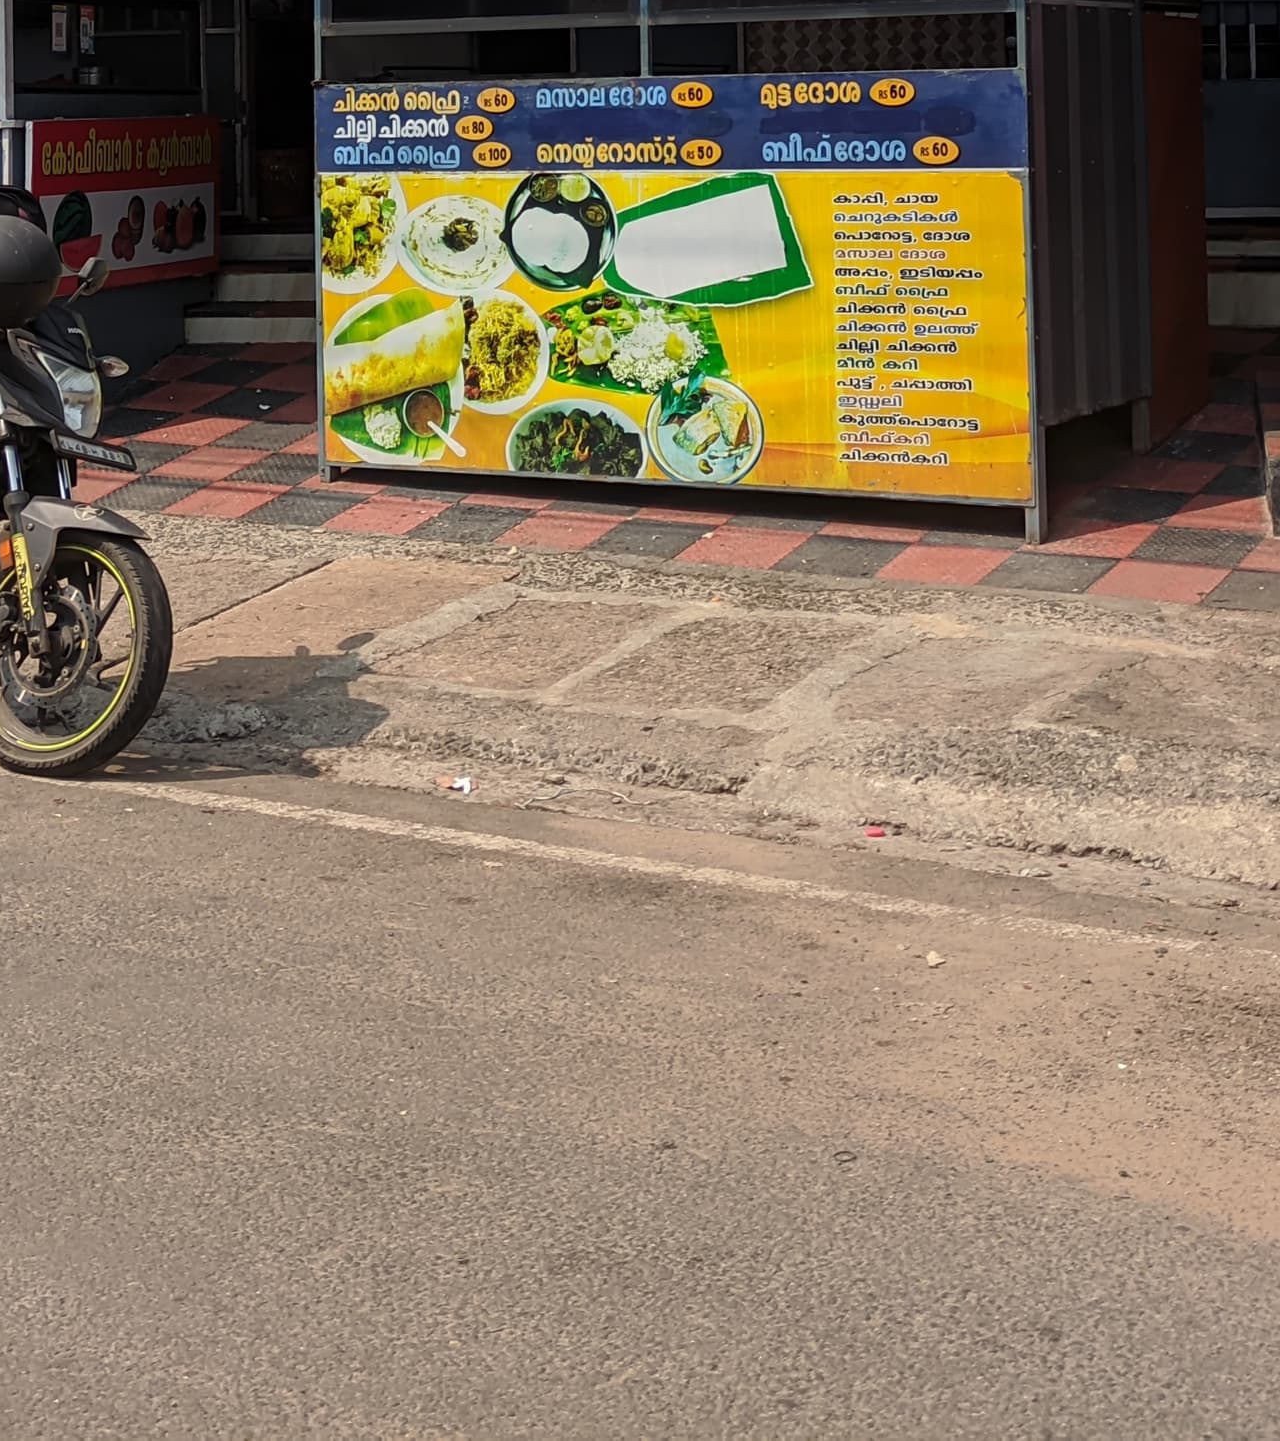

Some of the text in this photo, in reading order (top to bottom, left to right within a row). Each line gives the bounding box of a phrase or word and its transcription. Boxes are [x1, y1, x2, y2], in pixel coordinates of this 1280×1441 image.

[535, 87, 606, 108] മസാല
[688, 87, 703, 102] 60
[878, 84, 906, 99] RS 60
[332, 87, 400, 113] ചിക്കൻ
[494, 94, 508, 107] 60
[378, 114, 450, 139] ചിക്കൻ
[471, 121, 485, 135] 80
[488, 148, 507, 161] 100
[697, 146, 713, 160] 50
[920, 142, 948, 156] RS 60
[894, 193, 939, 205] ചായ
[833, 210, 959, 225] ചെറുകടികൾ
[922, 231, 971, 242] ദോശ
[835, 249, 946, 260] മസാല ദോശ
[899, 266, 984, 280] ഇടിയപ്പം
[835, 283, 890, 297] ബീഫ്
[835, 301, 906, 315] ചിക്കൻ
[836, 320, 907, 333] ചിക്കൻ
[836, 338, 958, 354] ചില്ലി ചിക്കൻ
[836, 357, 918, 371] മീൻ കറി
[891, 378, 973, 391] ചപ്പാത്തി
